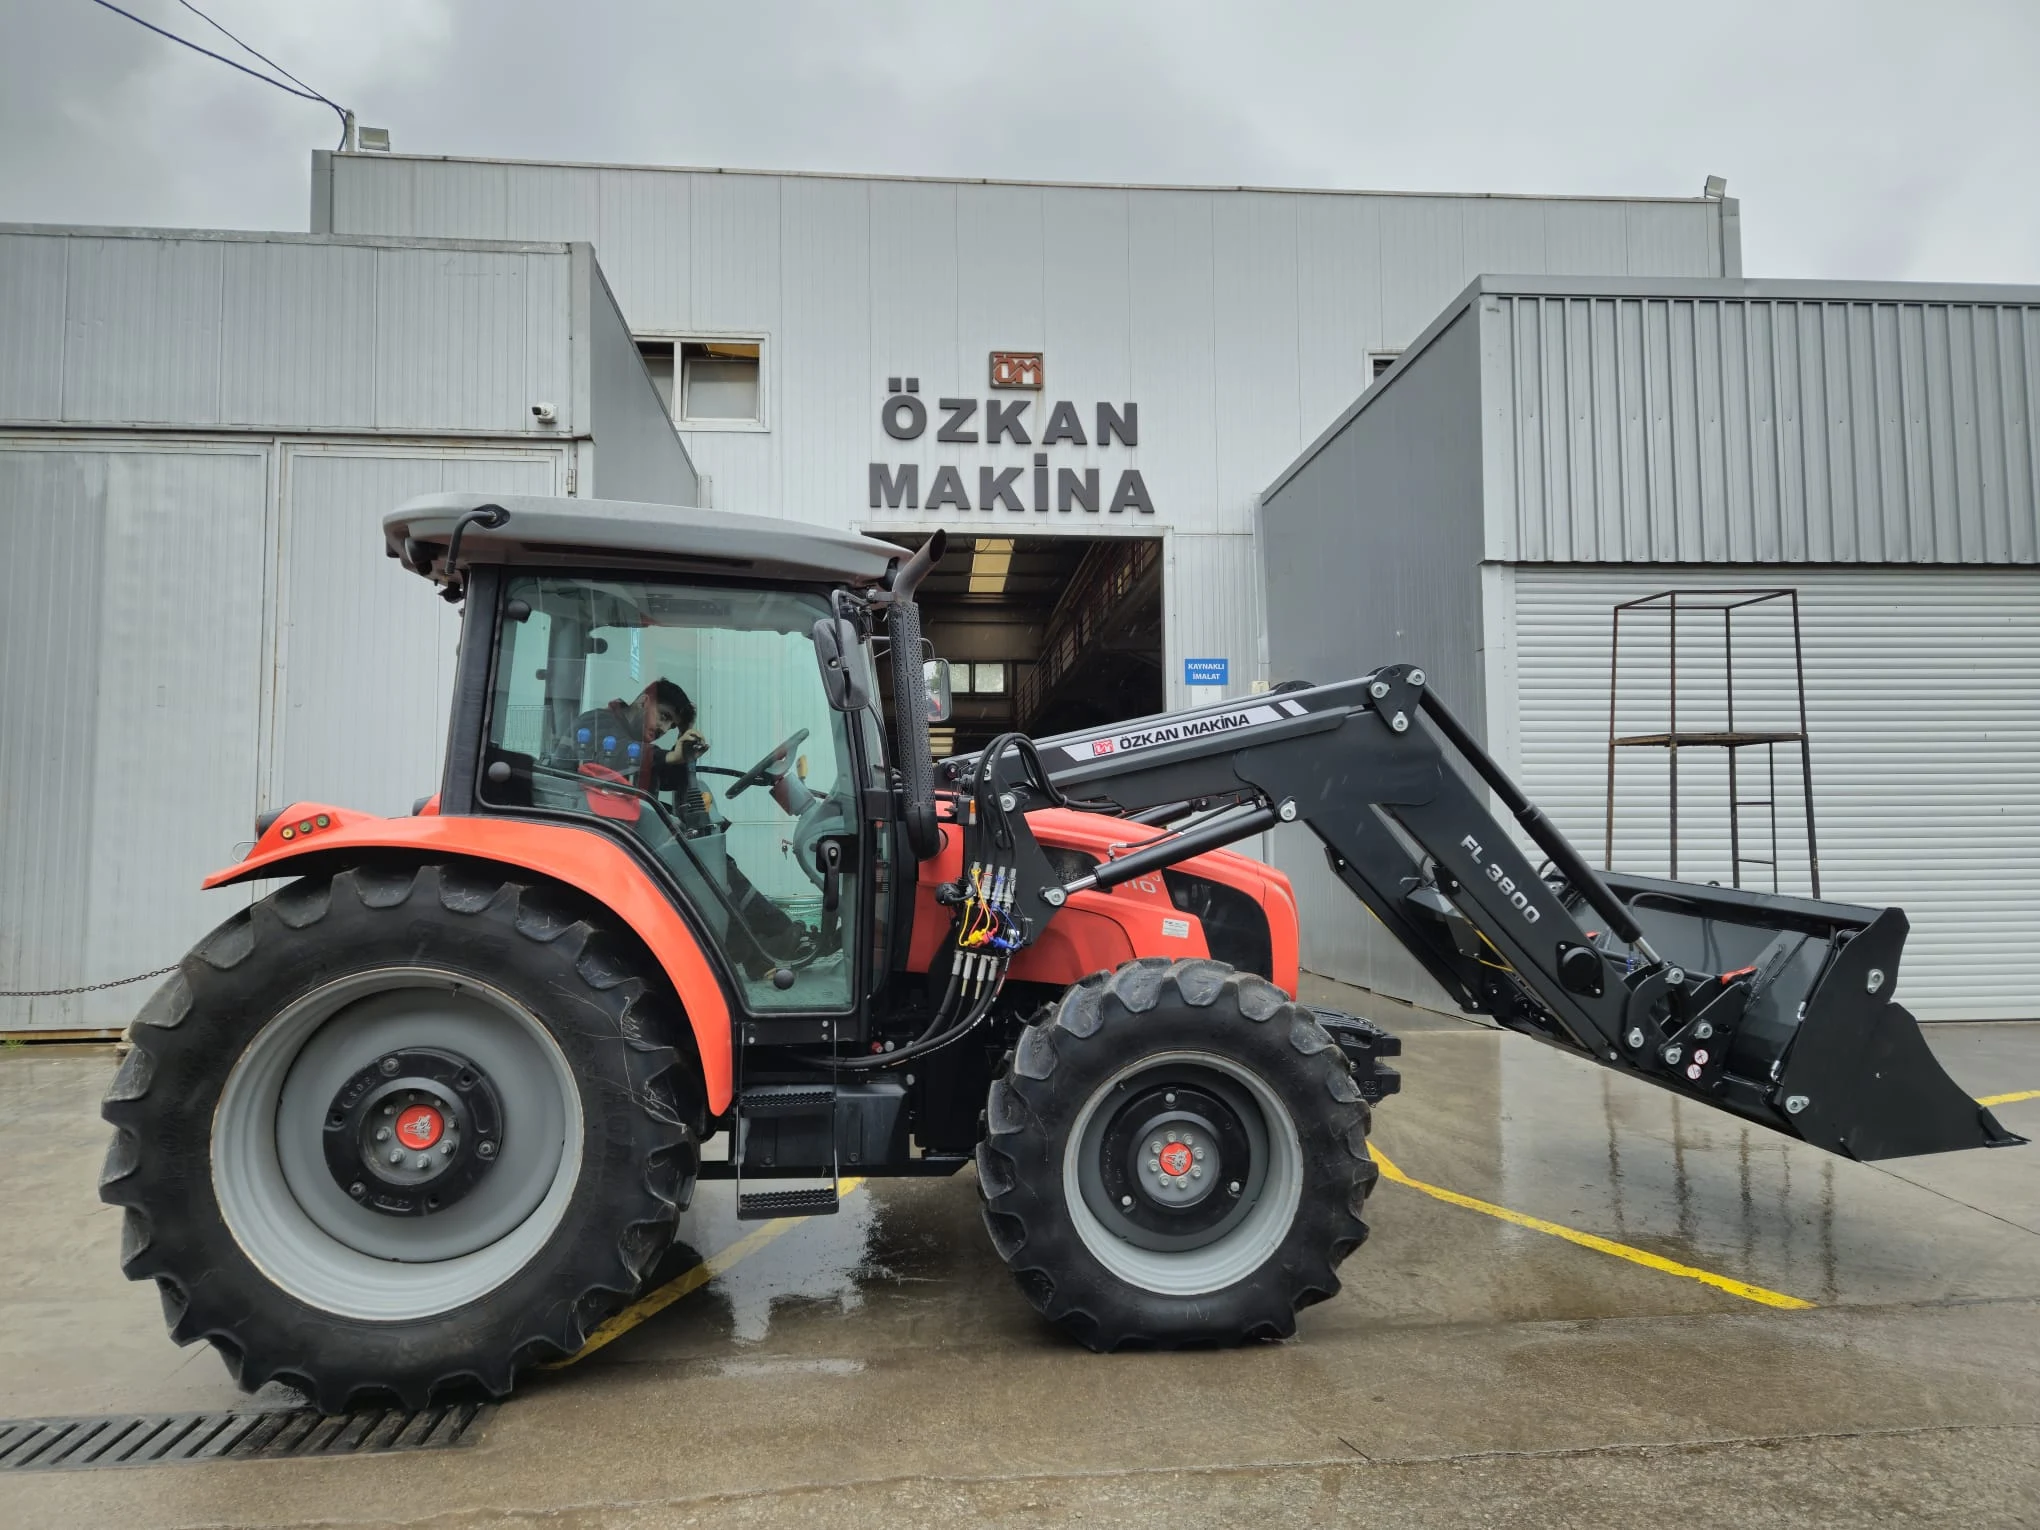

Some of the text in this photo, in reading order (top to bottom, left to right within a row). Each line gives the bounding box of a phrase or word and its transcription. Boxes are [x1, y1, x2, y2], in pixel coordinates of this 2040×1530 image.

[882, 377, 1137, 446] ÖZKAN
[869, 453, 1155, 513] MAKİNA
[1192, 671, 1221, 680] İMALAT
[1119, 727, 1179, 750] ÖZKAN
[1183, 713, 1250, 737] MAKİNA
[1460, 834, 1540, 924] FL 3800
